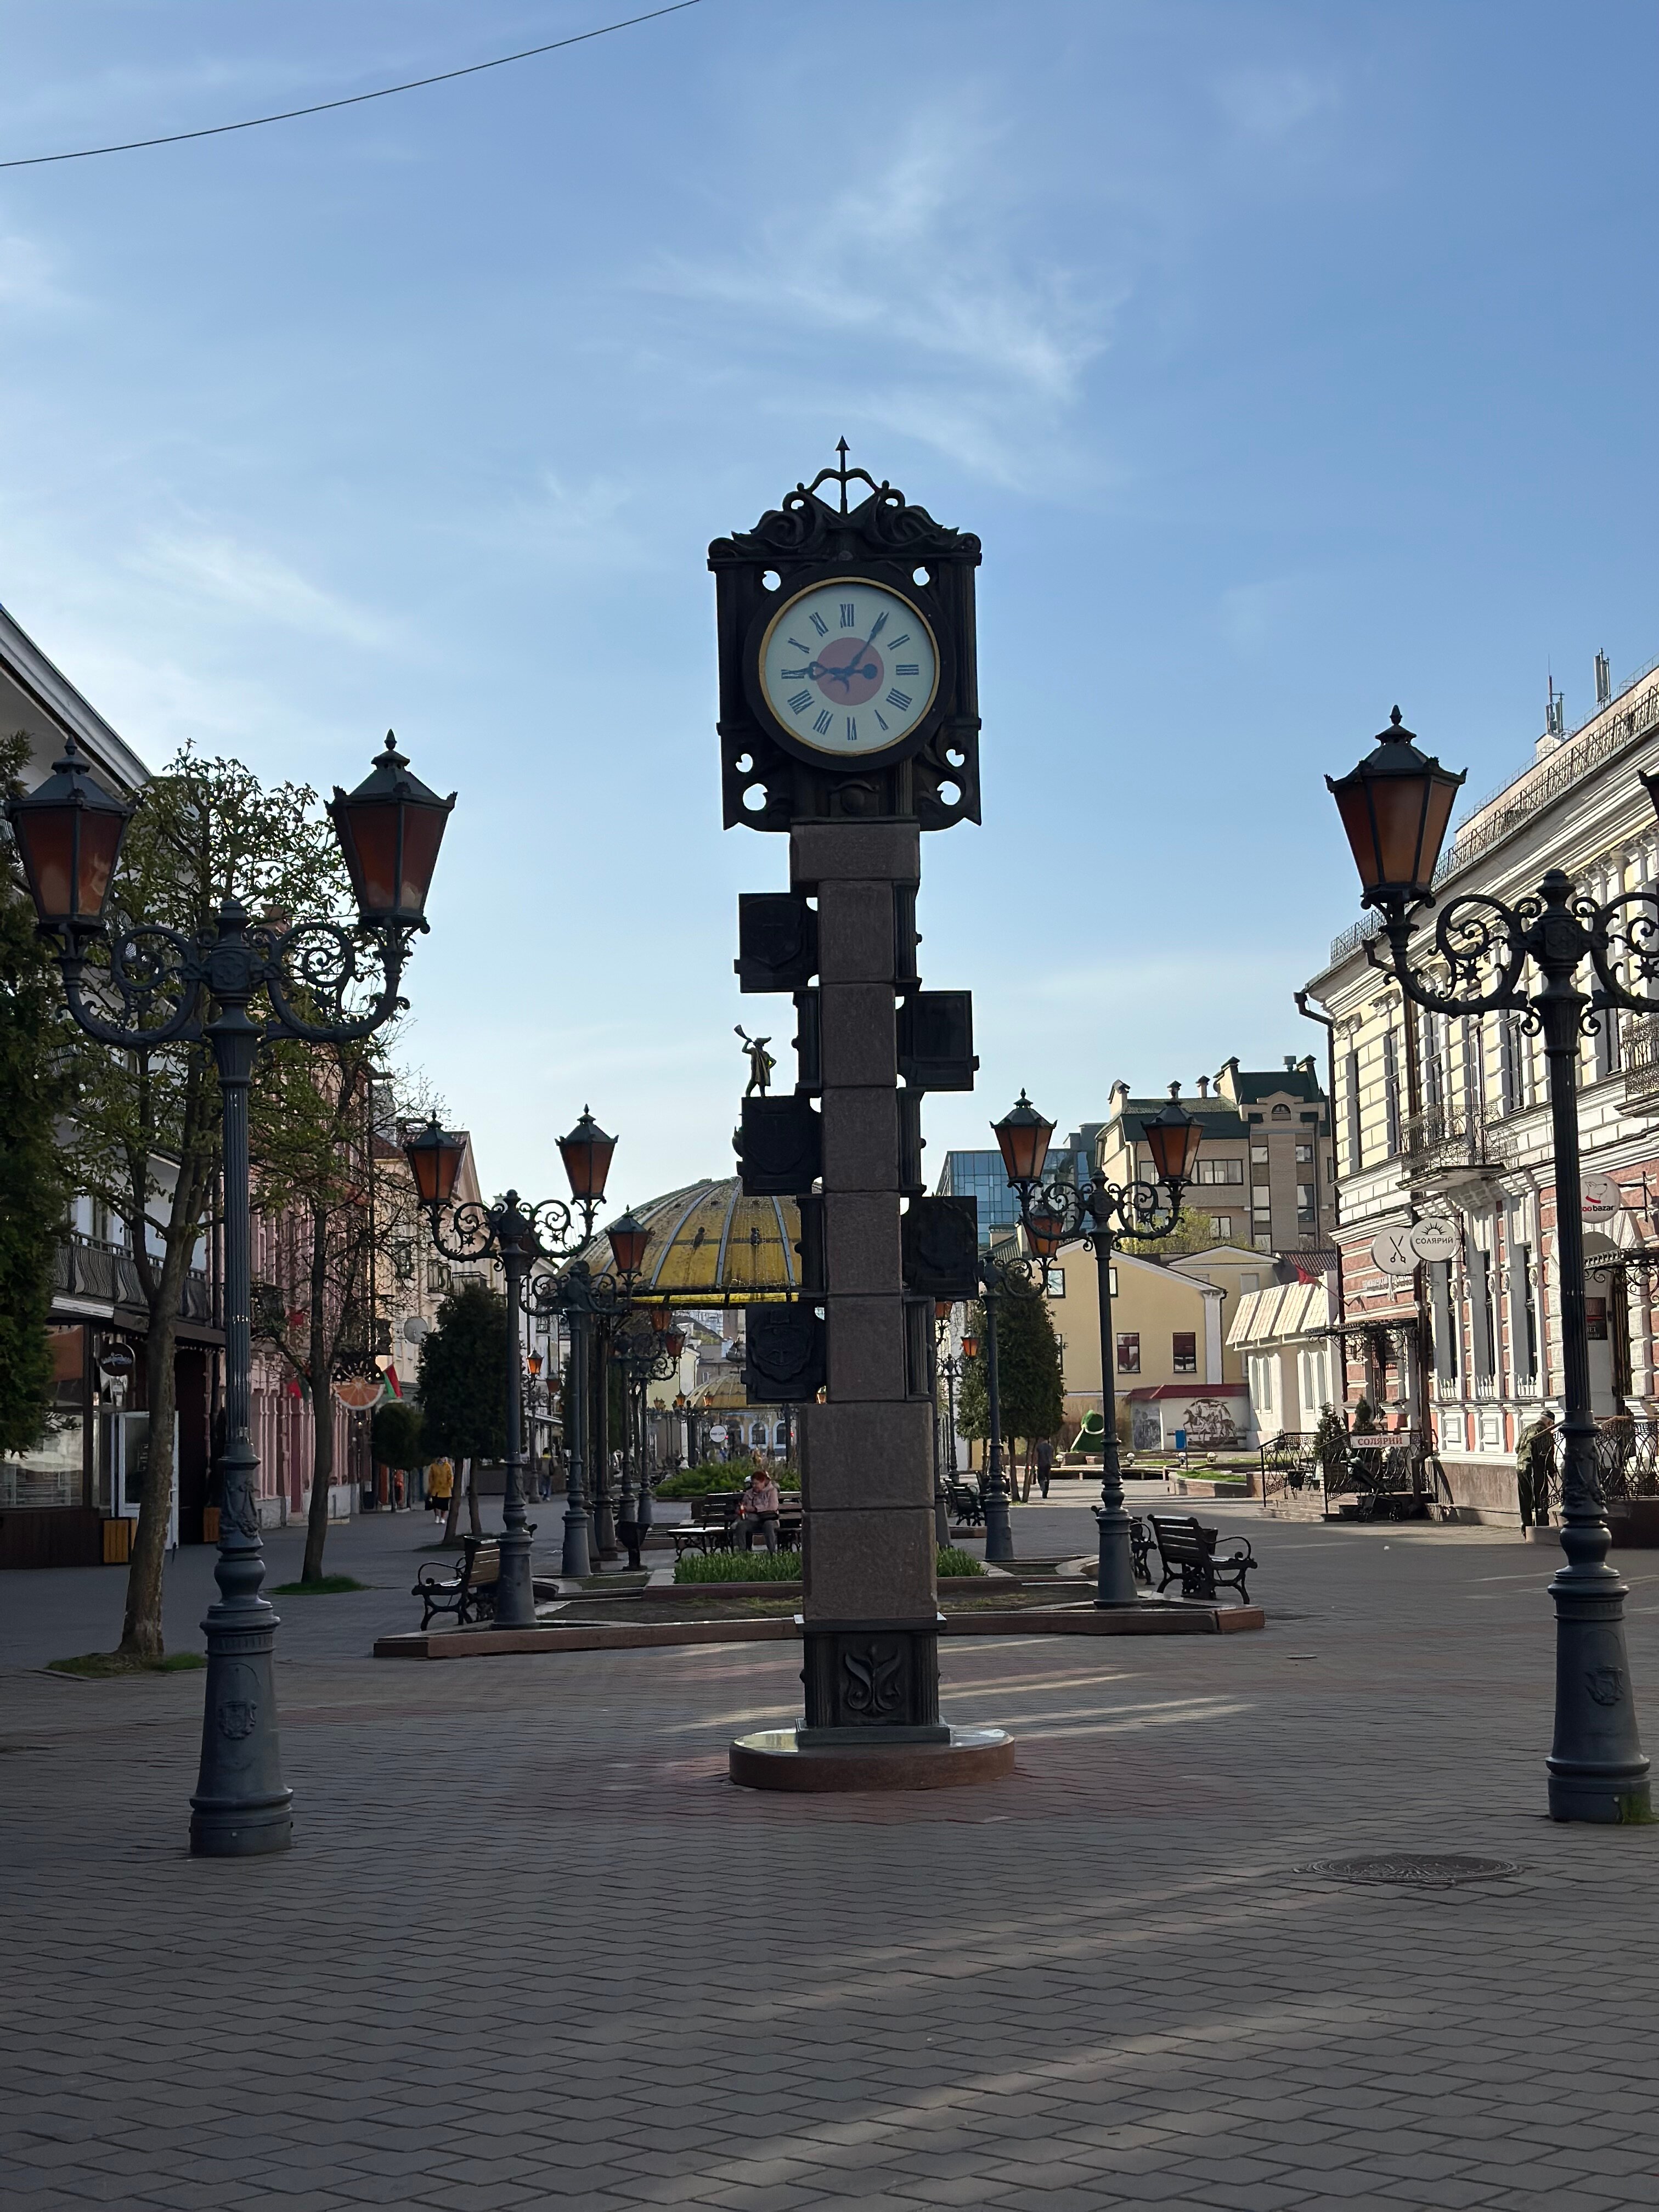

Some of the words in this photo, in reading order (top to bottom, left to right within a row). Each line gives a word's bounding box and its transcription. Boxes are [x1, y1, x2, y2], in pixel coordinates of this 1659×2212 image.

[809, 612, 828, 636] XI
[840, 604, 854, 628] XII
[788, 637, 810, 653] X
[887, 634, 910, 650] II
[896, 664, 919, 675] III
[787, 689, 815, 715] VIII
[886, 688, 912, 712] IIII
[812, 709, 833, 735] VII
[847, 716, 857, 740] VI
[874, 709, 889, 731] V
[1415, 1236, 1453, 1244] СОЛЯРИЙ
[1358, 1435, 1403, 1445] СОЛЯРИЙ
